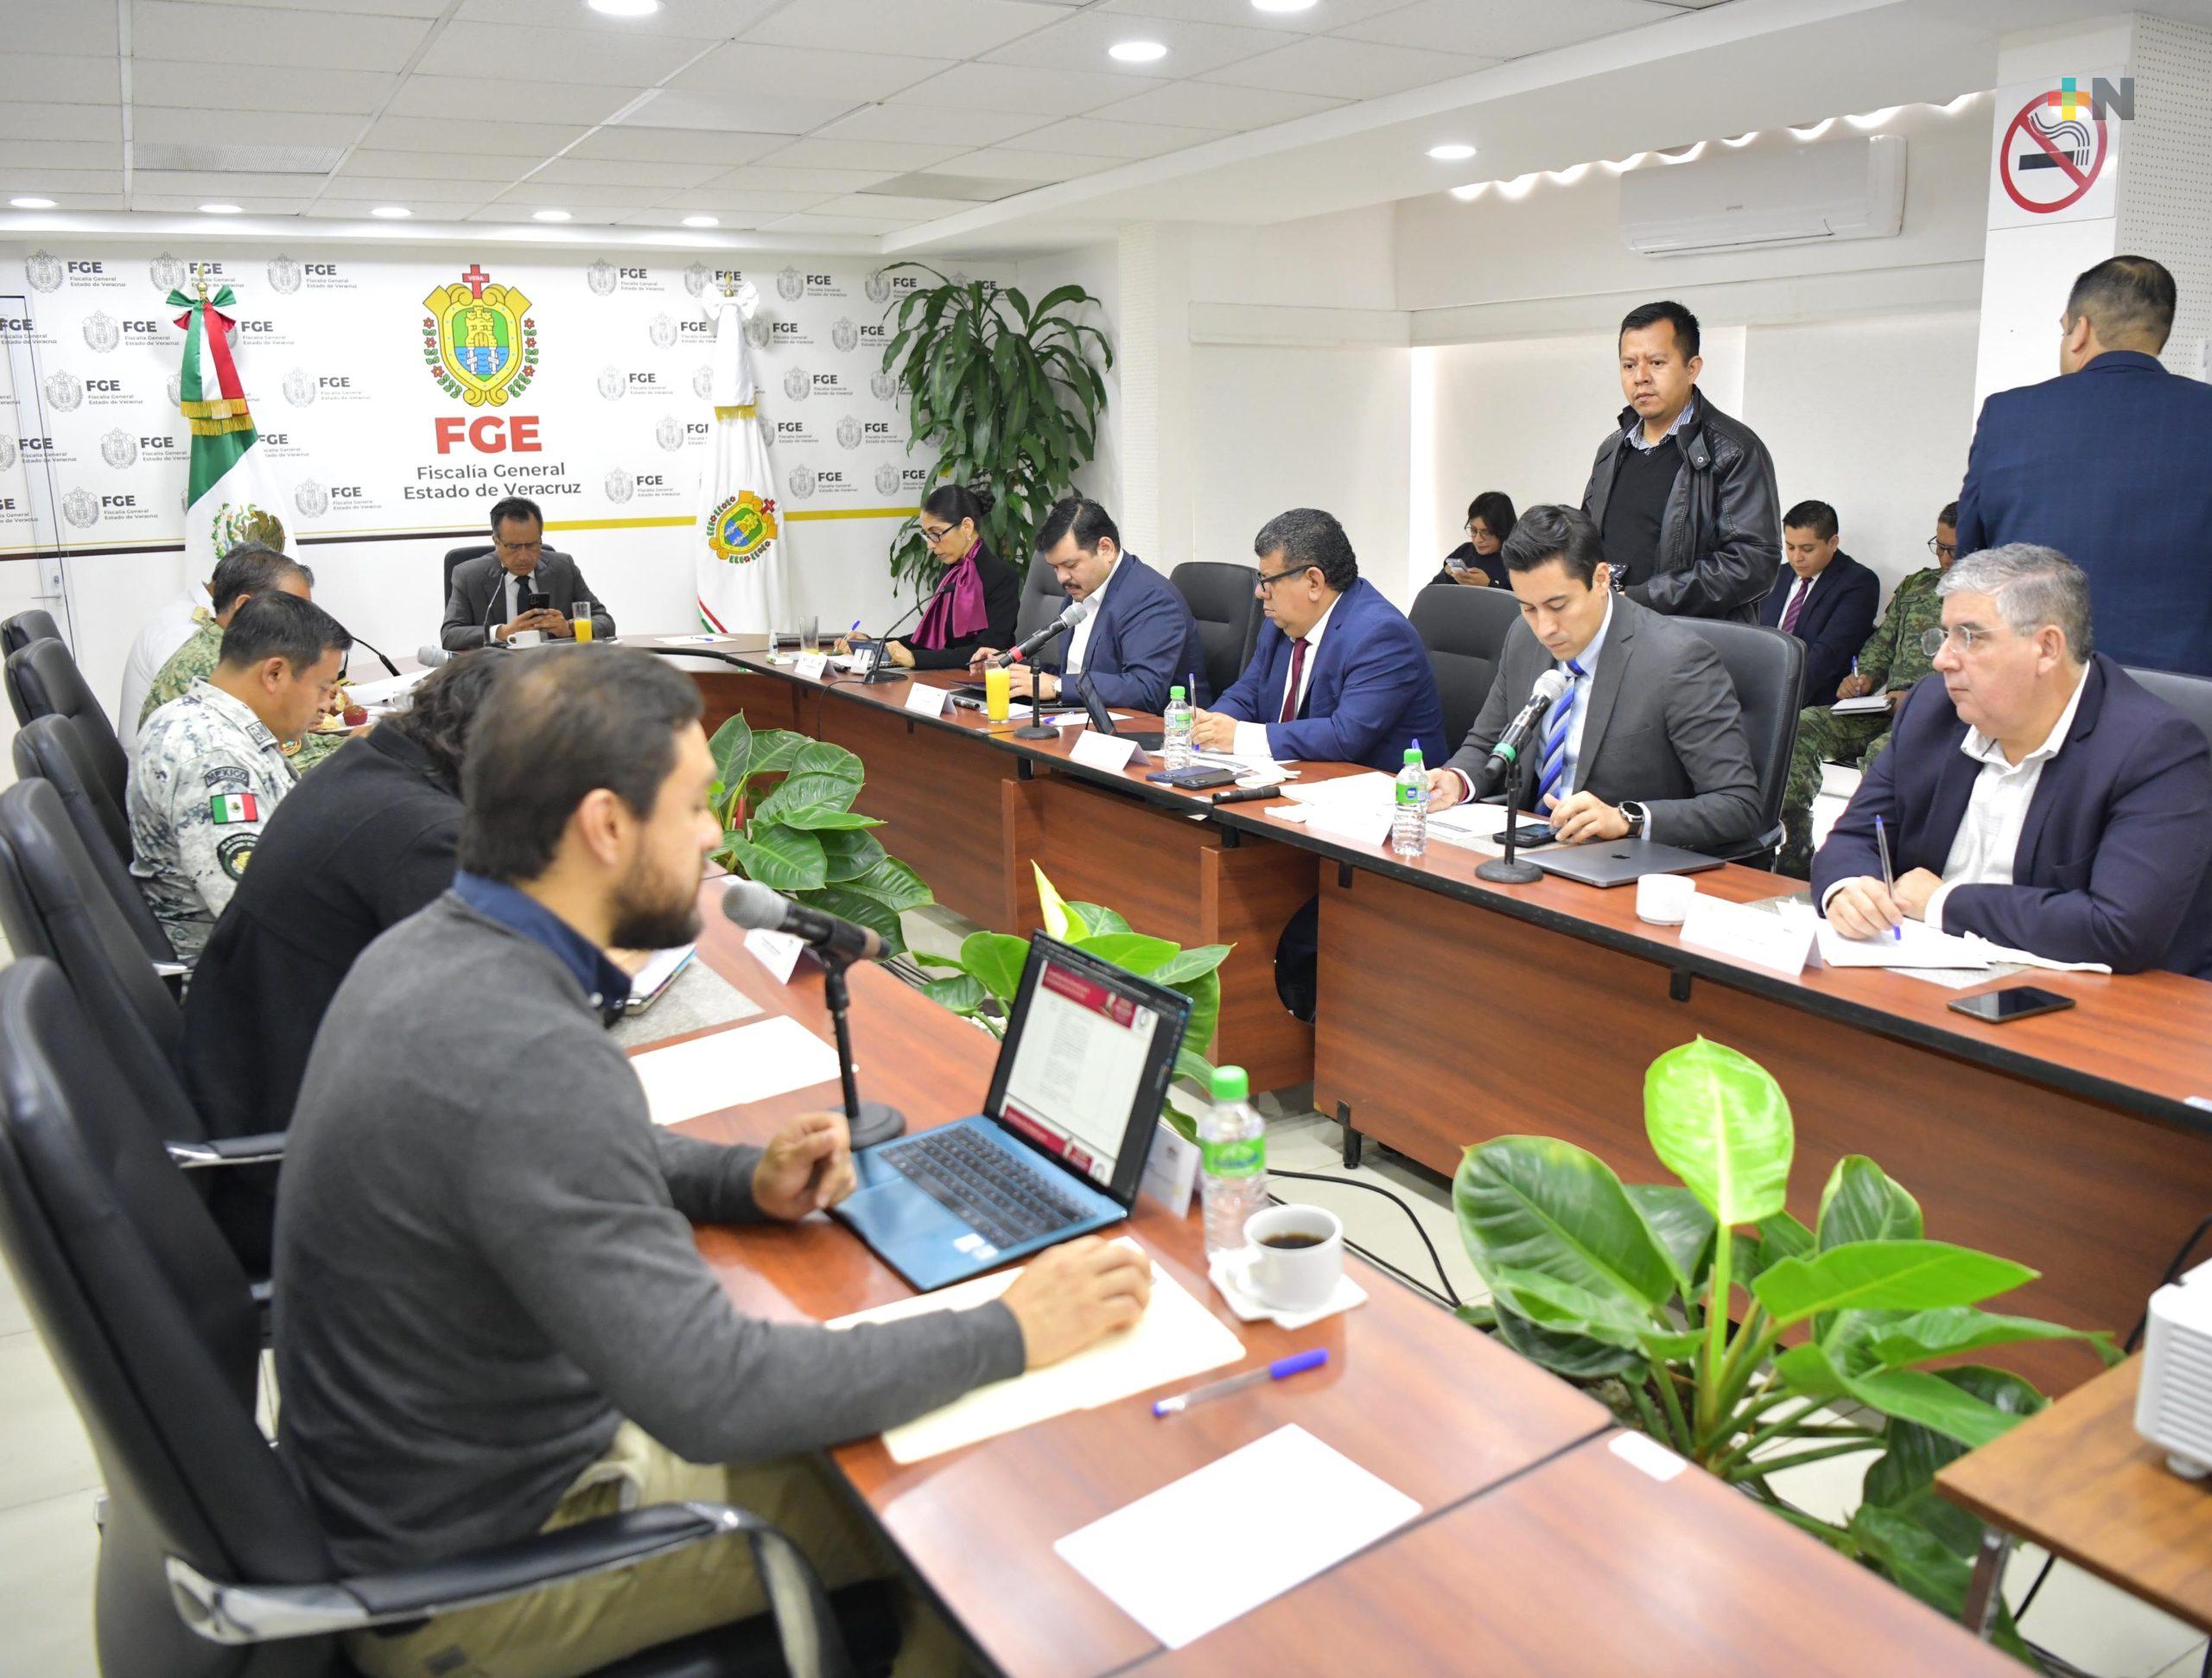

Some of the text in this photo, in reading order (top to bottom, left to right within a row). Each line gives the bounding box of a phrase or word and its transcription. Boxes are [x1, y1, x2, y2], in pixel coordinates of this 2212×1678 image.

[68, 262, 103, 273] FGE
[305, 264, 336, 275] FGE
[620, 269, 647, 278] FGE
[807, 276, 831, 285] FGE
[893, 278, 917, 287] FGE
[0, 320, 34, 330] FGE
[123, 321, 157, 332] FGE
[241, 321, 273, 332] FGE
[681, 322, 707, 332] FGE
[773, 323, 798, 333] FGE
[861, 327, 885, 335] FGE
[320, 377, 350, 387] FGE
[629, 373, 656, 383] FGE
[813, 375, 838, 384] FGE
[86, 380, 120, 391] FGE
[778, 423, 803, 432] FGE
[865, 423, 888, 432] FGE
[435, 416, 542, 454] FGE
[19, 438, 53, 450] FGE
[141, 437, 174, 448] FGE
[416, 462, 565, 480] Fiscalía General
[903, 470, 925, 479] FGE
[637, 476, 663, 486] FGE
[818, 473, 842, 481] FGE
[332, 487, 362, 498] FGE
[404, 483, 581, 499] Estado de Veracruz
[102, 496, 136, 506] FGE
